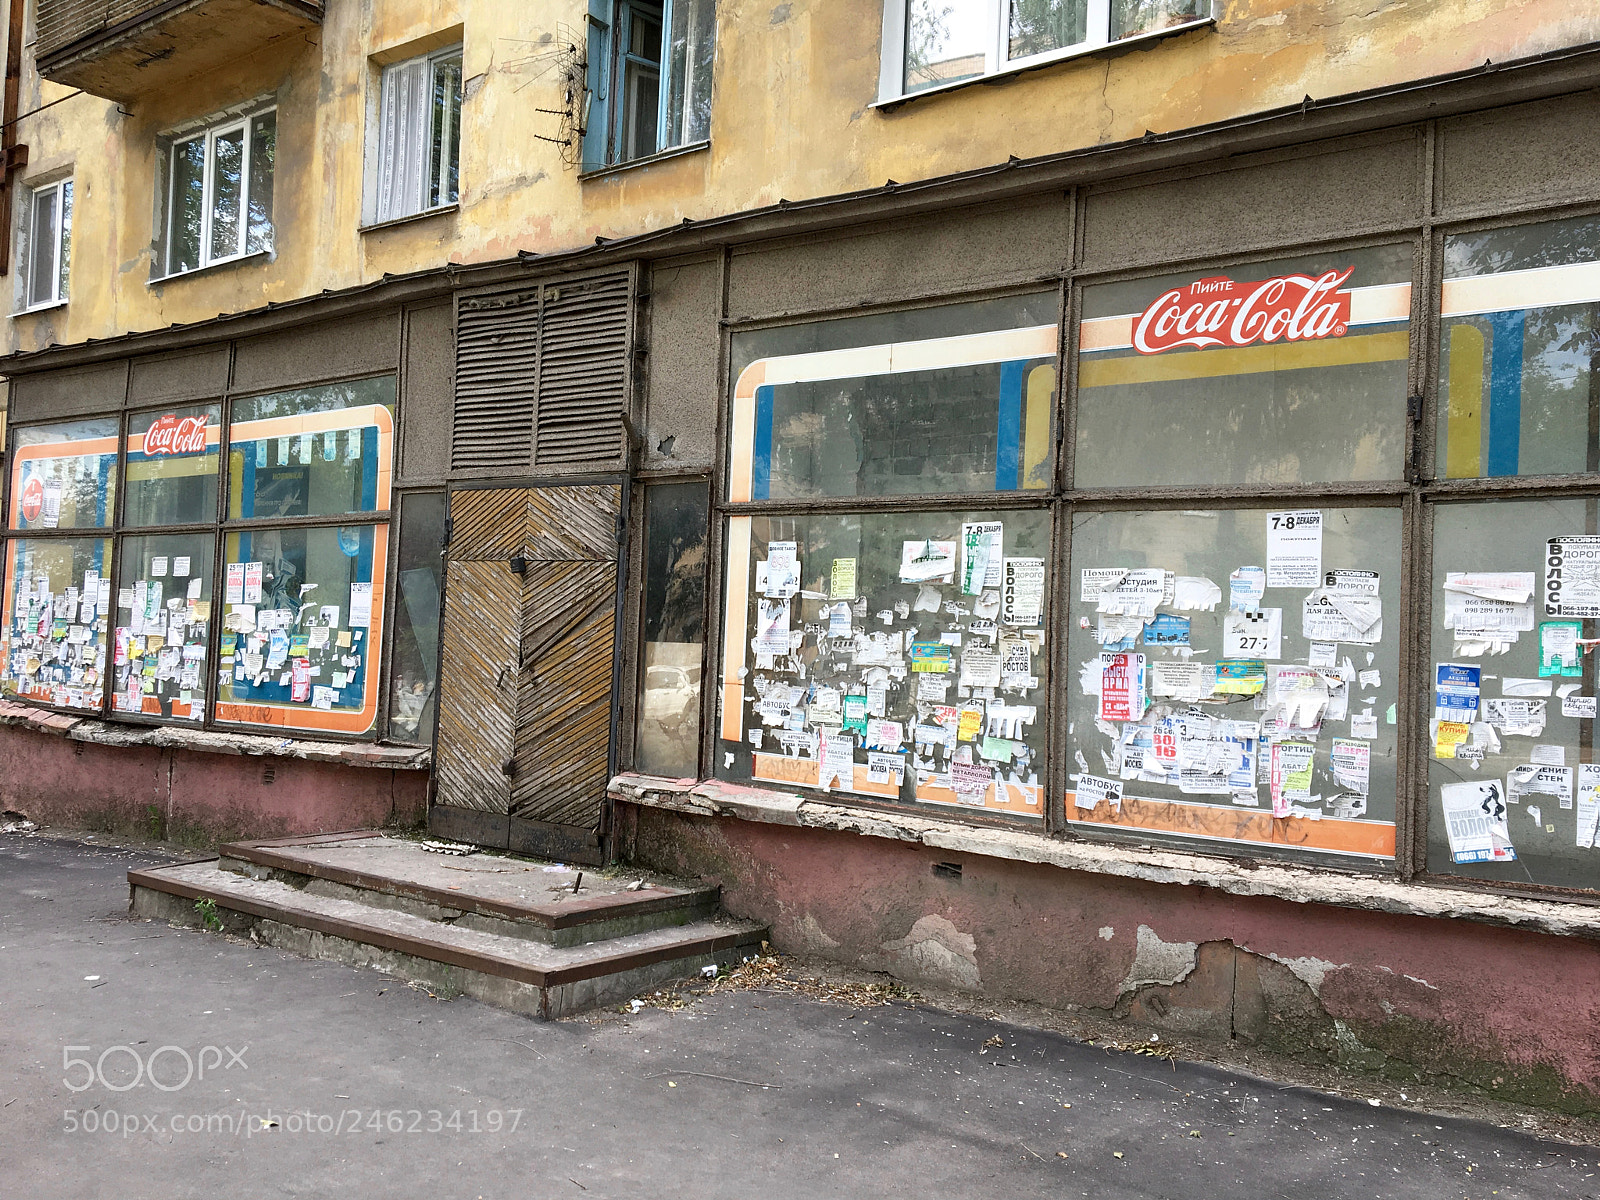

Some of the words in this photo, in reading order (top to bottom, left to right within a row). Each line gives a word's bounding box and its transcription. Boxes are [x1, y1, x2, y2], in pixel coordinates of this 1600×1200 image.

[1134, 265, 1355, 353] Coca-Cola
[143, 414, 208, 455] Coca-Cola
[1271, 516, 1295, 530] 7-8
[1296, 516, 1320, 525] ДЕКАБРЯ
[1545, 544, 1563, 615] ВОЛОСЫ
[1003, 567, 1015, 623] ВОЛОСЫ
[1002, 662, 1029, 672] РОСТОВ
[762, 700, 790, 709] АВТОБУС
[1439, 726, 1467, 734] КУПИМ
[1155, 745, 1177, 757] 16
[1080, 774, 1121, 793] АВТОБУС
[1537, 774, 1564, 782] СТЕН
